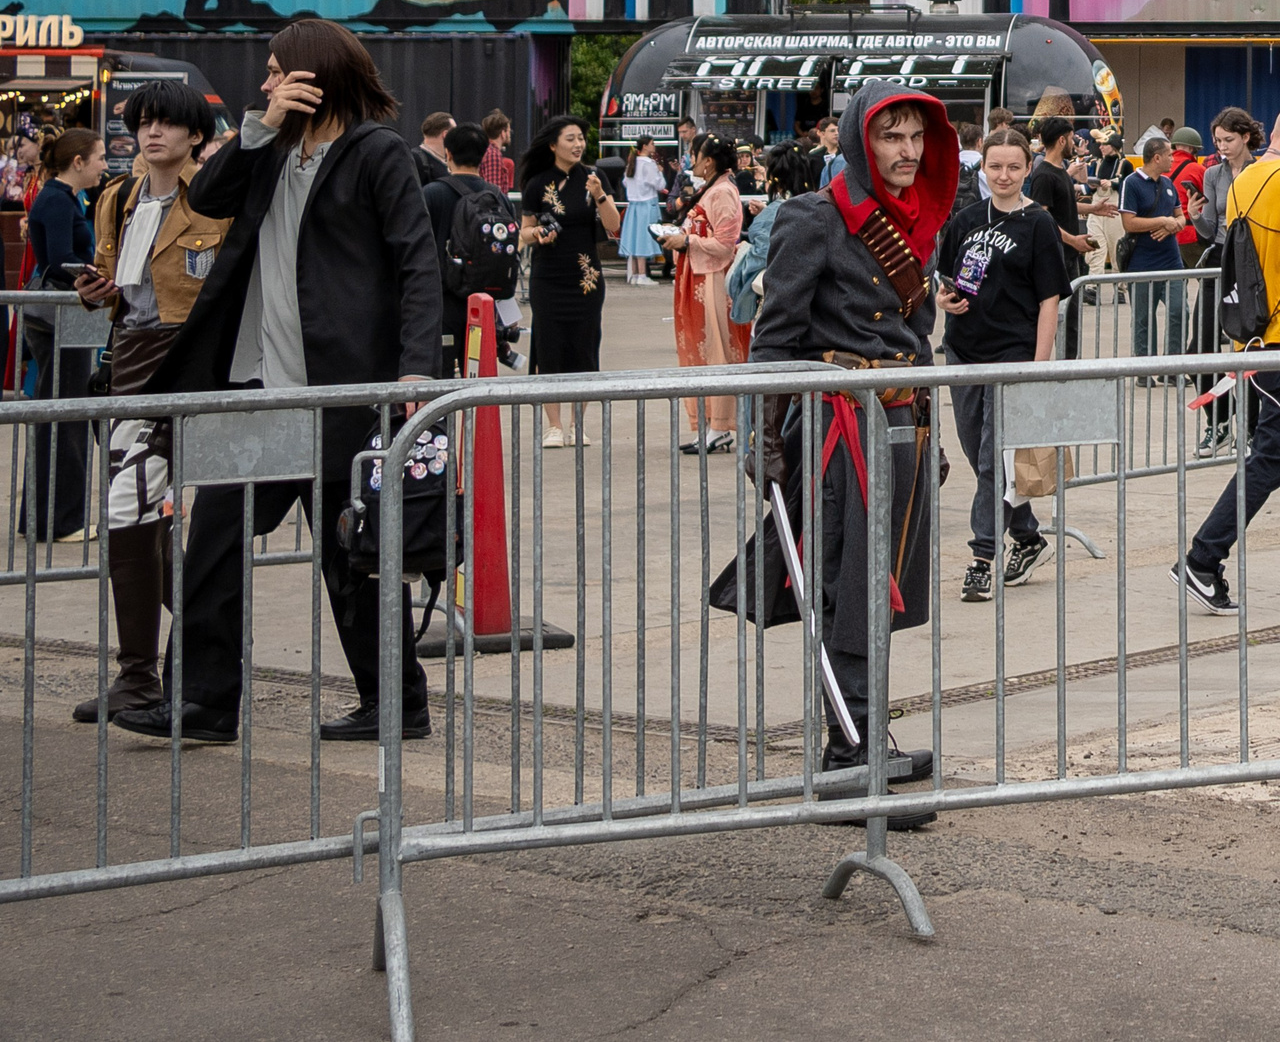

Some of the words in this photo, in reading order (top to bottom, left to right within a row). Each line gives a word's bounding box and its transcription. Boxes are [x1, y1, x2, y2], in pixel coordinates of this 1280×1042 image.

[696, 35, 783, 49] АВТОРСКАЯ
[784, 35, 853, 49] ШАУРМА,
[855, 35, 883, 49] ГДЕ
[885, 35, 934, 48] АВТОР
[945, 35, 973, 47] ЭТО
[976, 35, 1001, 47] ВЫ
